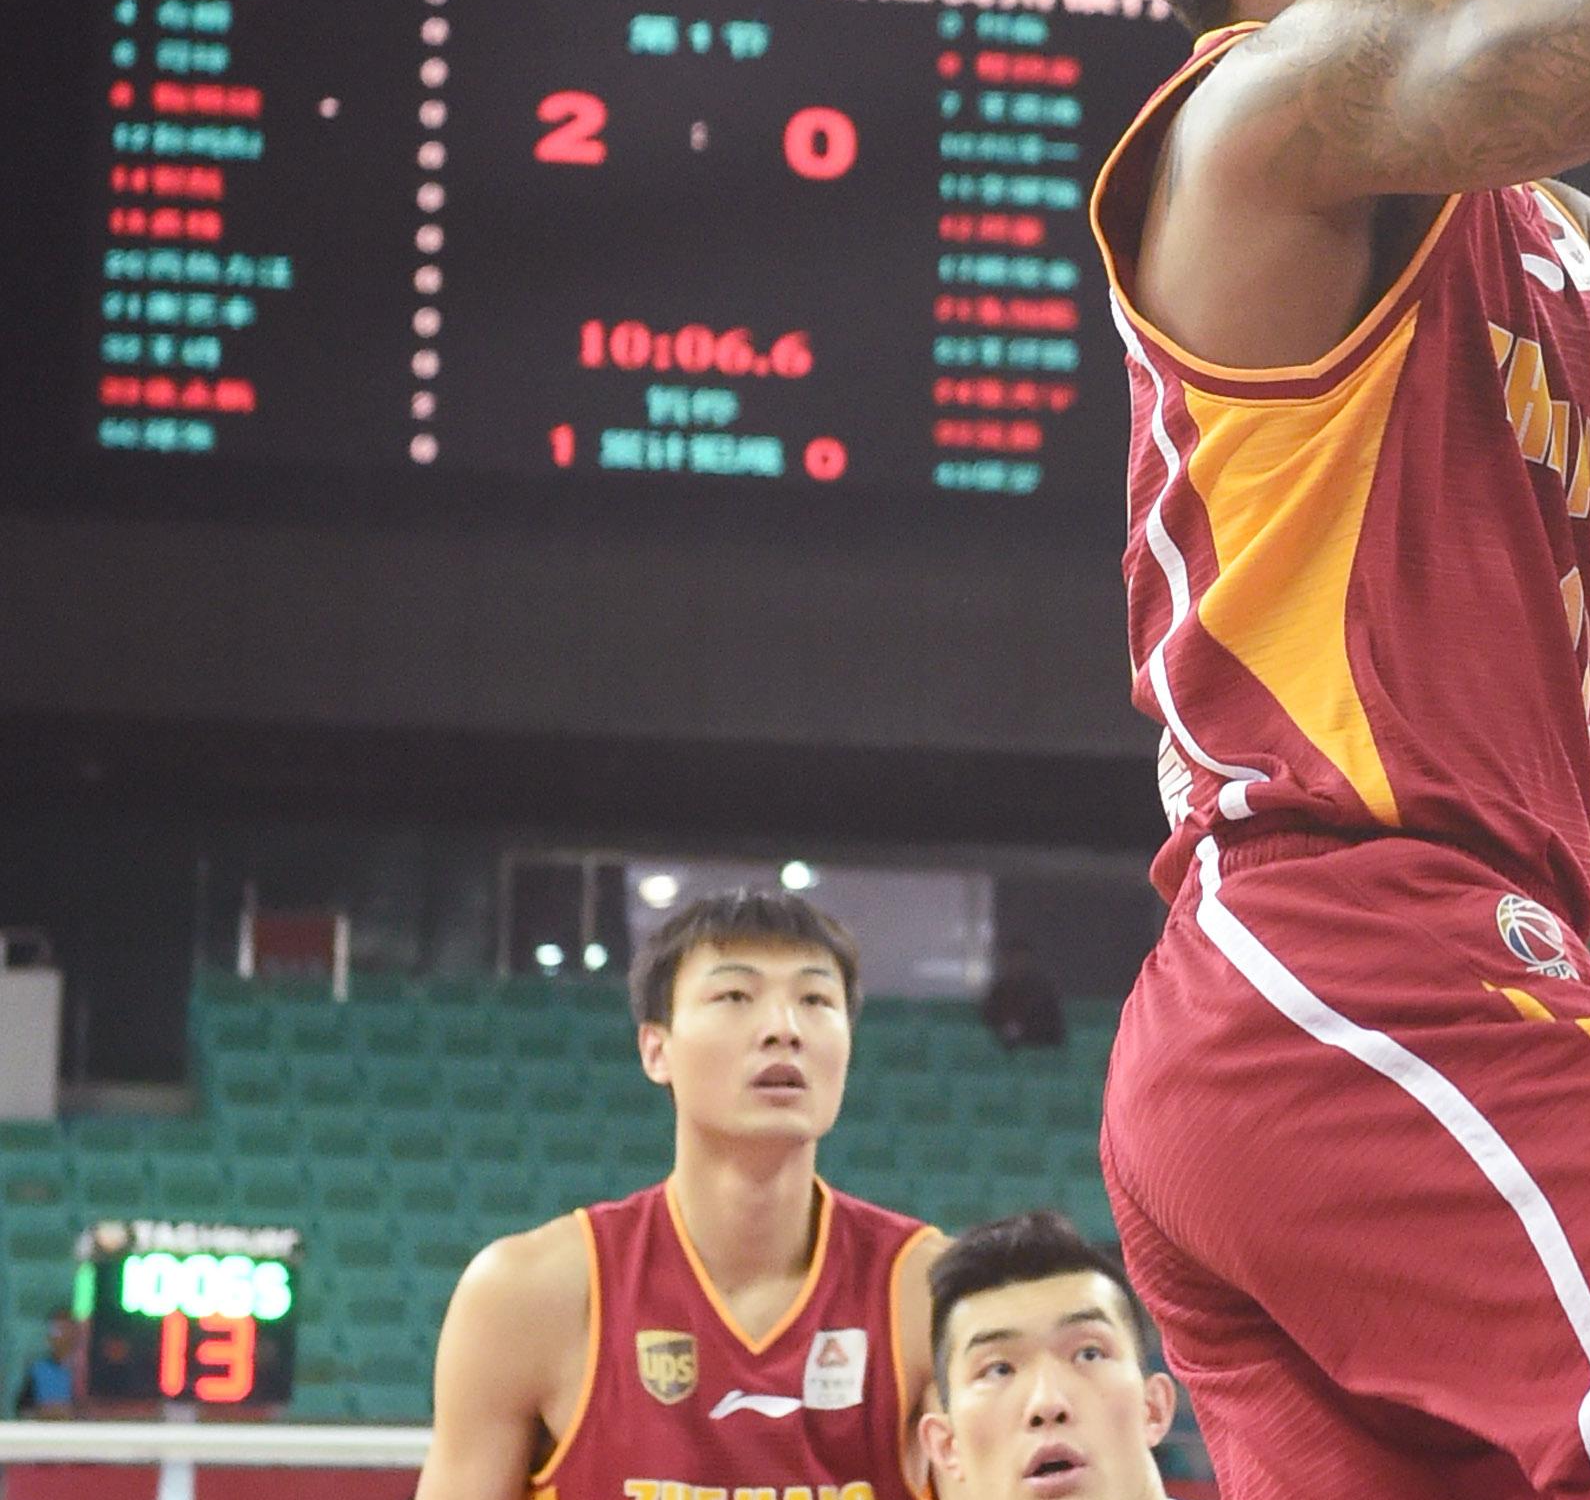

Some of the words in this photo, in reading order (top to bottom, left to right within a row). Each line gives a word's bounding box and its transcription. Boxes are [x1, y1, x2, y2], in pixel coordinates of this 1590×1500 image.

[533, 90, 607, 165] 2
[783, 106, 857, 180] 0
[159, 1308, 257, 1402] 13
